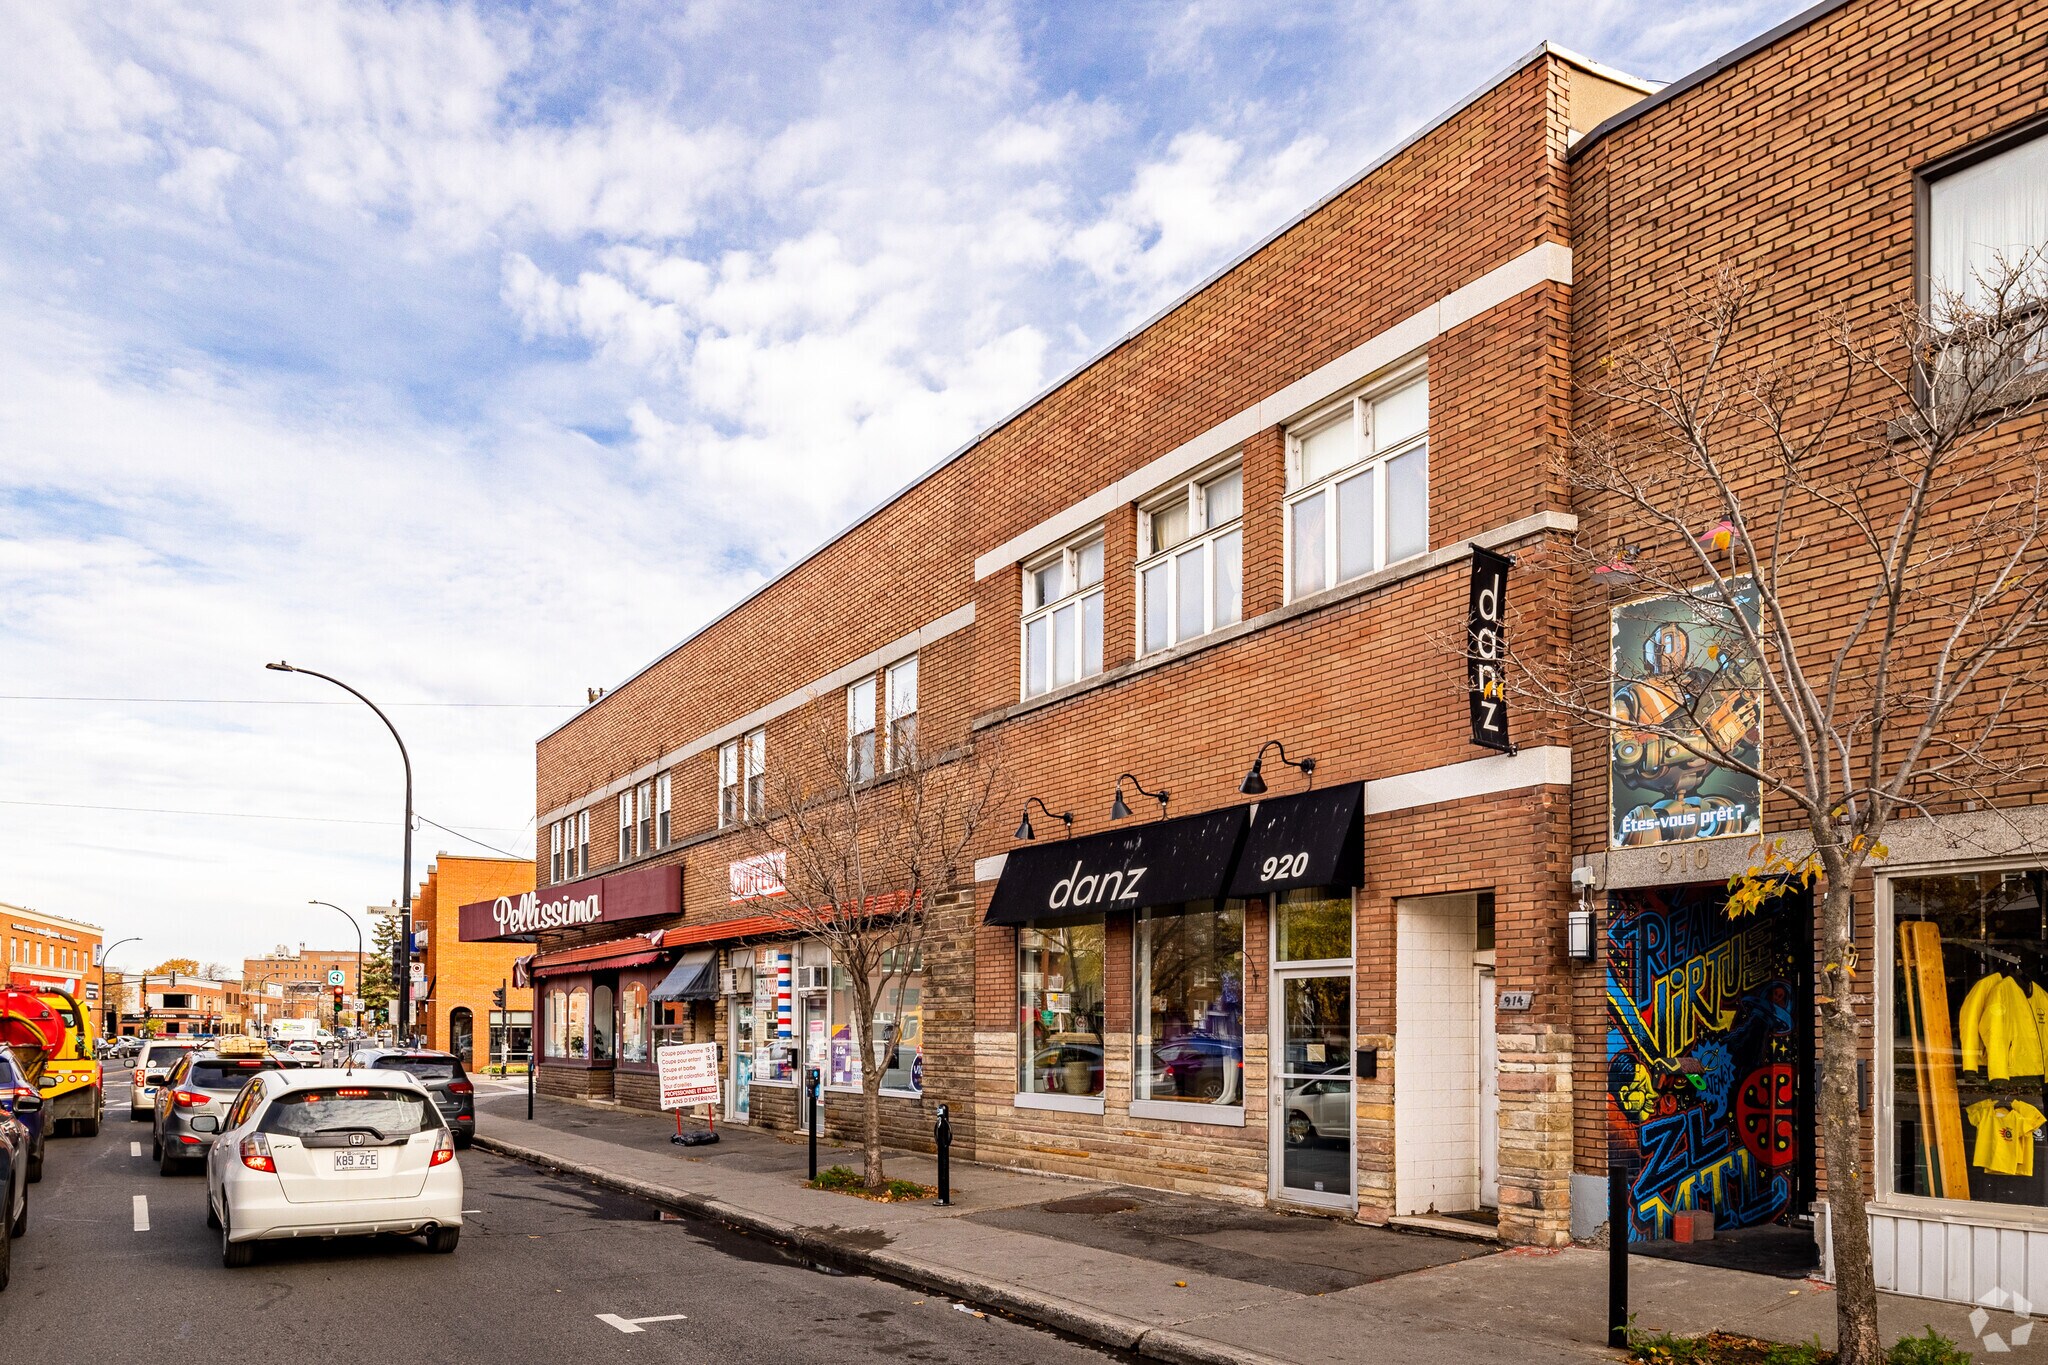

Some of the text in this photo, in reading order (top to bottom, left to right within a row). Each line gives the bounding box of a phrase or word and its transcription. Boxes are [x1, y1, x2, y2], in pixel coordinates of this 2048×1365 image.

[1478, 573, 1500, 732] danz
[1622, 813, 1696, 833] Êtes-vous
[1260, 852, 1309, 882] 920
[1658, 845, 1709, 874] 910
[1049, 860, 1148, 910] danz
[493, 891, 603, 936] Pellissima
[354, 1002, 364, 1010] 50
[1504, 996, 1524, 1007] 914
[336, 1154, 377, 1166] K89 ZFE
